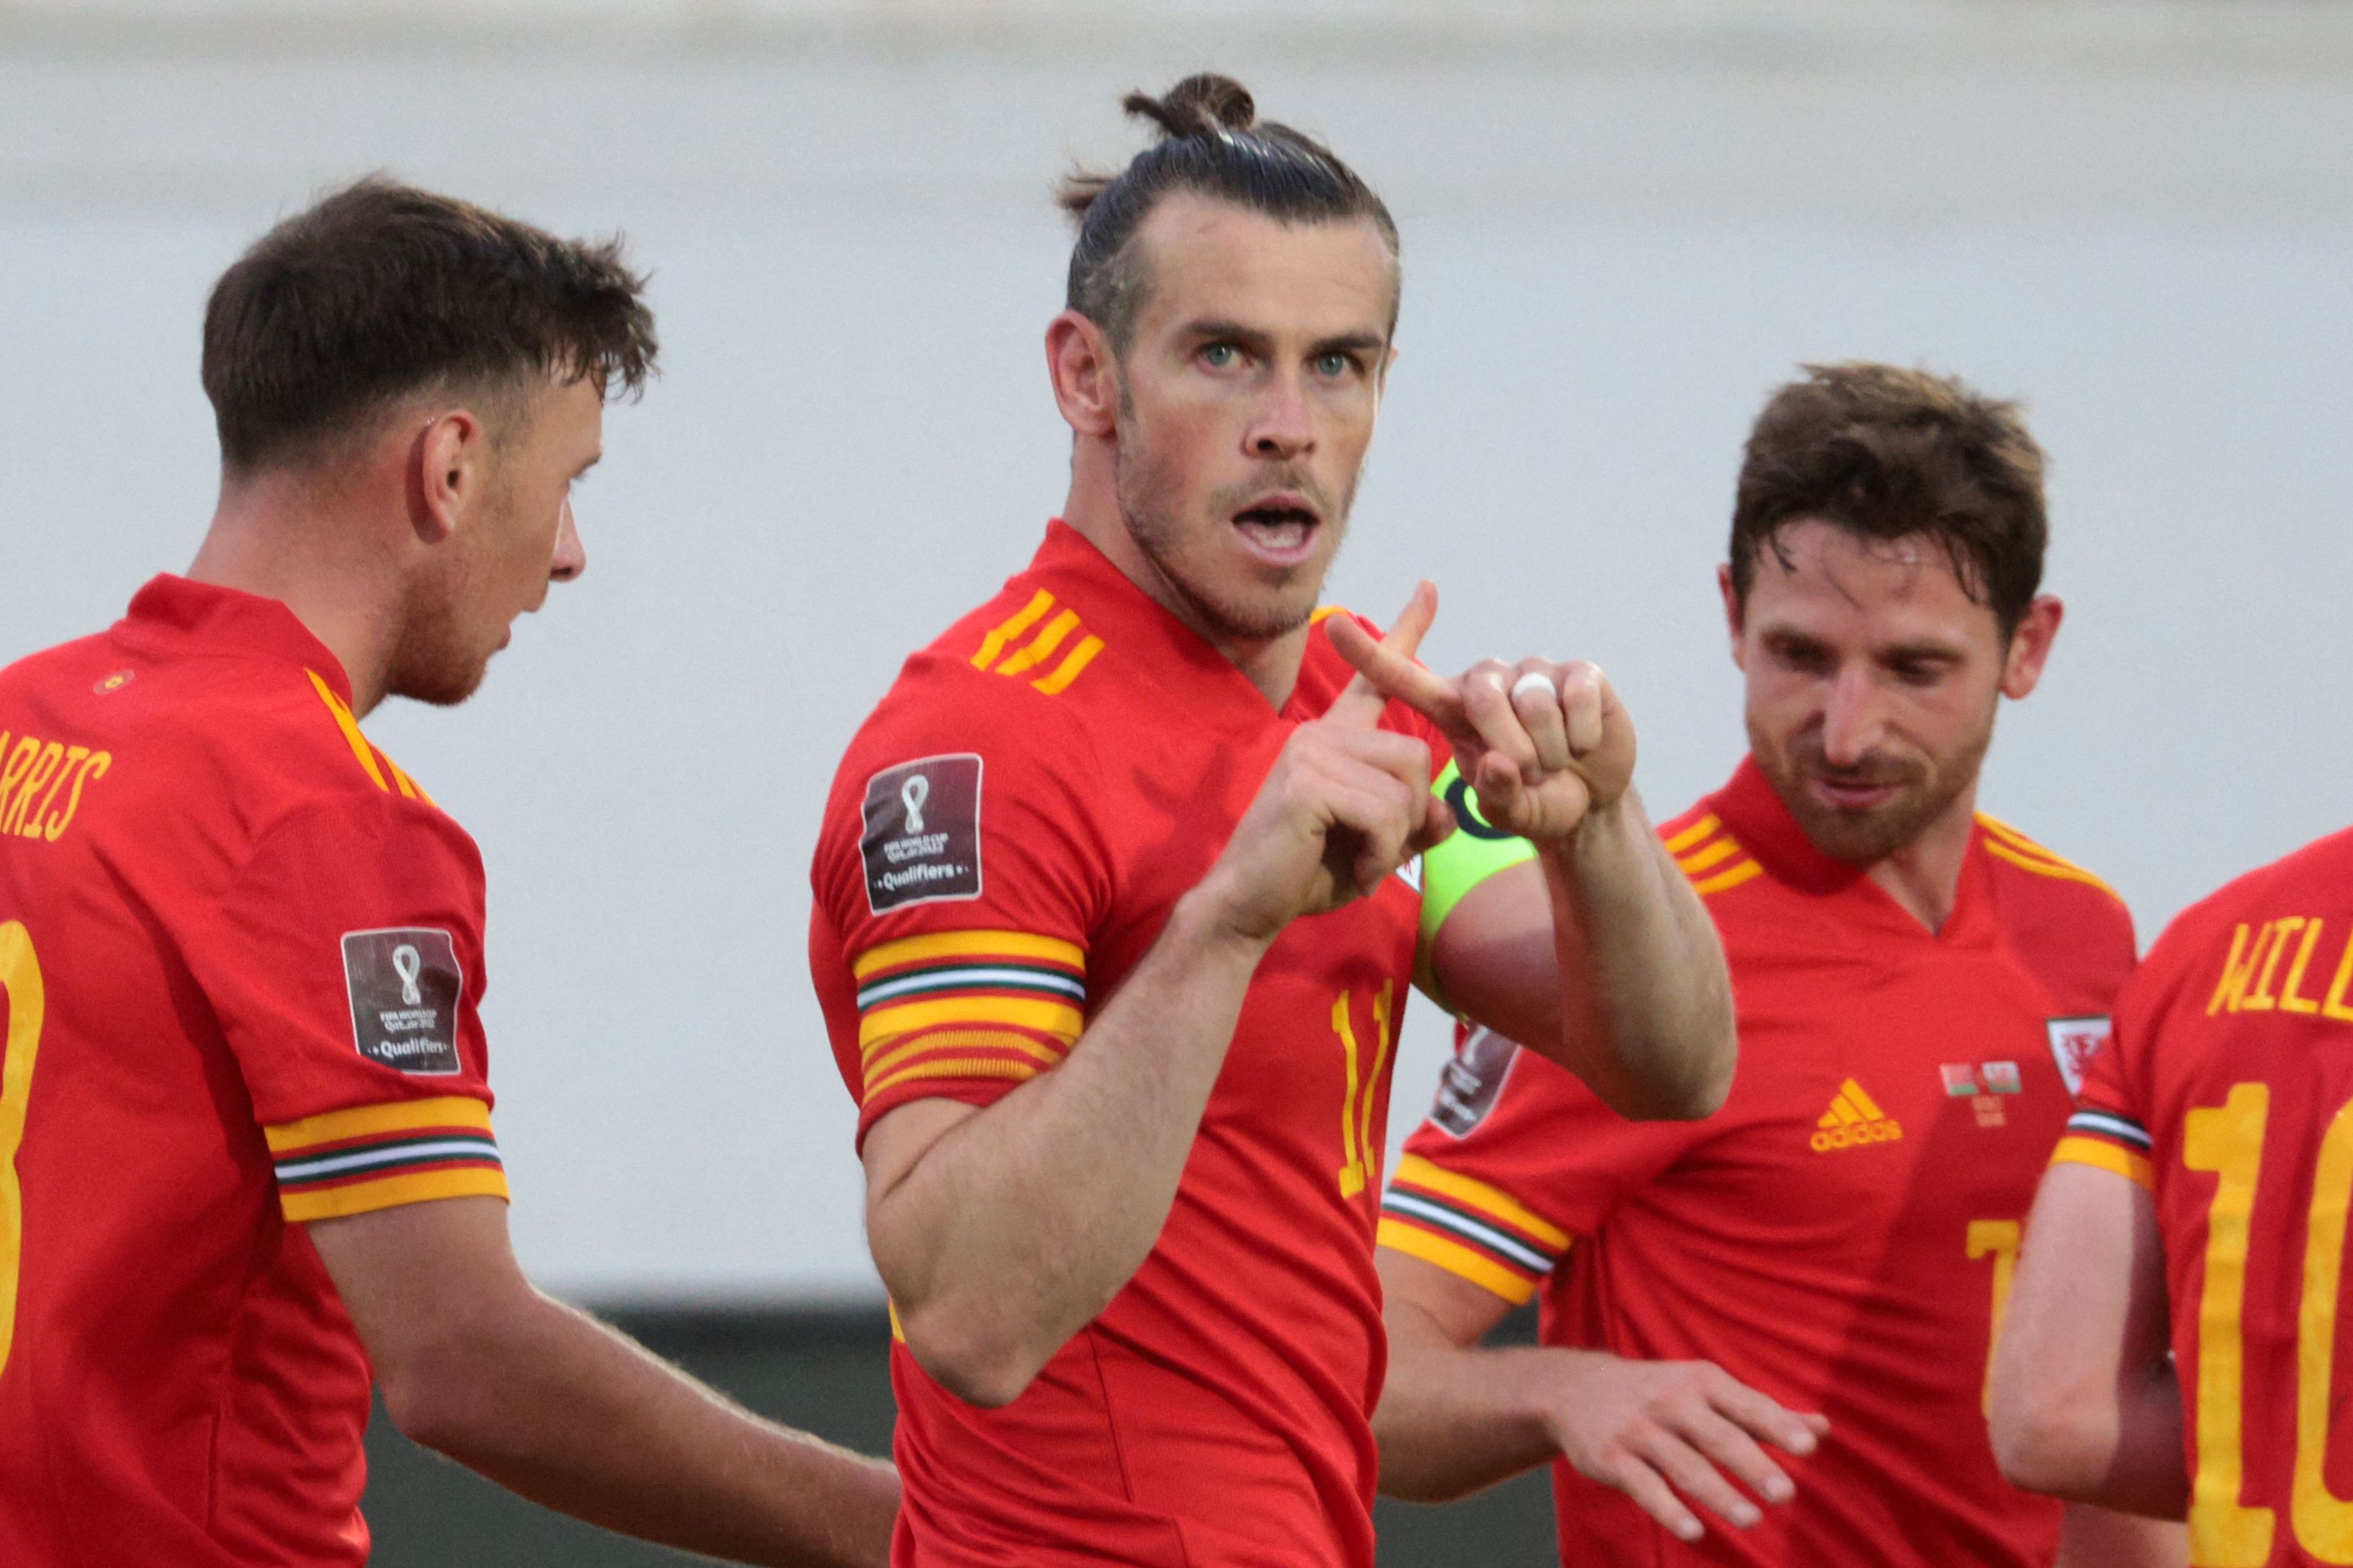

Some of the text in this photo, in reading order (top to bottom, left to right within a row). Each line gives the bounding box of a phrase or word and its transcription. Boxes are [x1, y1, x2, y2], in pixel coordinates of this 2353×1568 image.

[883, 863, 955, 892] Qualifiers
[380, 1036, 444, 1059] Qualifiers
[1809, 1119, 1903, 1152] adidas
